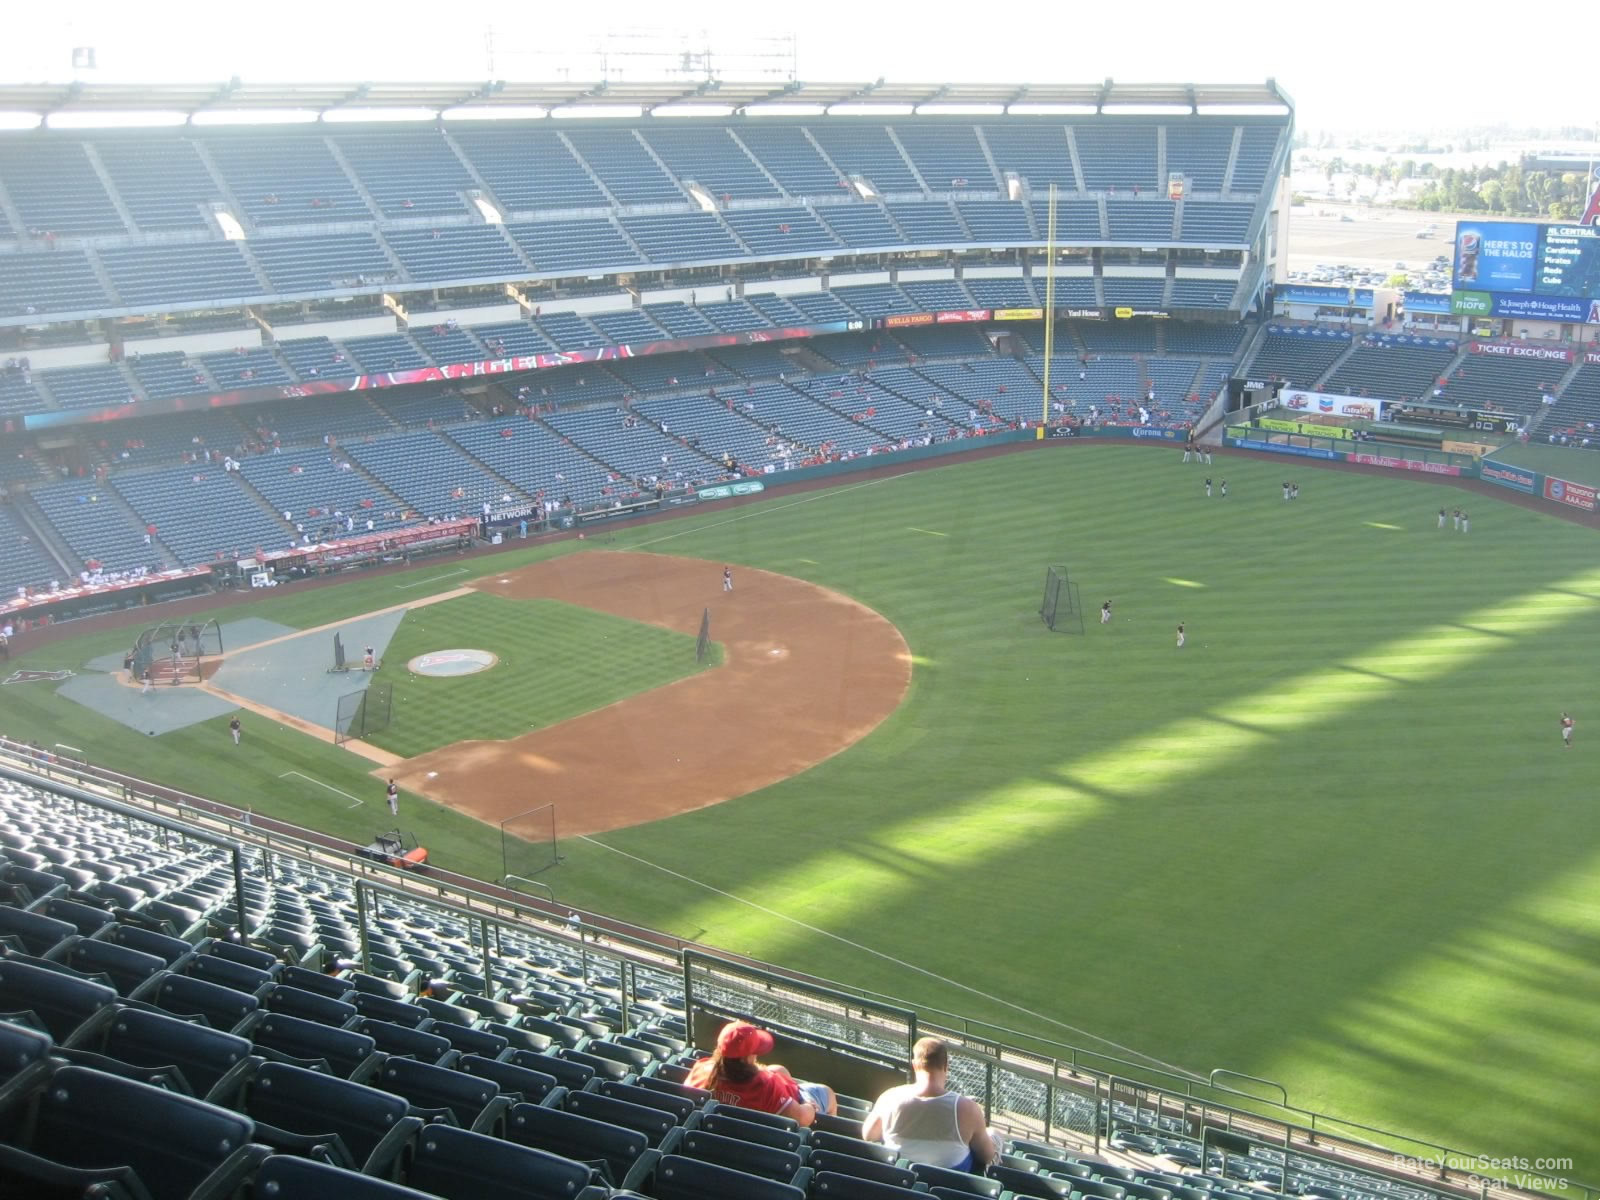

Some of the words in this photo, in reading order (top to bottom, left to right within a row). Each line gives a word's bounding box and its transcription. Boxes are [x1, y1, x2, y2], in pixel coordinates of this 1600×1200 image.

[1559, 227, 1597, 237] CENTRAL
[1483, 239, 1518, 250] HERE'S
[1519, 241, 1534, 251] TO
[1546, 236, 1579, 245] Brewers
[1483, 248, 1500, 257] THE
[1501, 249, 1533, 259] HALOS
[1545, 246, 1582, 255] Cardinals
[1544, 256, 1572, 265] Pirates
[1455, 300, 1486, 310] more
[1557, 303, 1581, 312] Health
[887, 317, 910, 326] WELLS
[911, 314, 933, 323] FARGO
[1477, 343, 1512, 355] TICKET
[1132, 427, 1162, 437] Corona
[490, 507, 533, 523] NETWORK
[1113, 1082, 1135, 1096] SECTION
